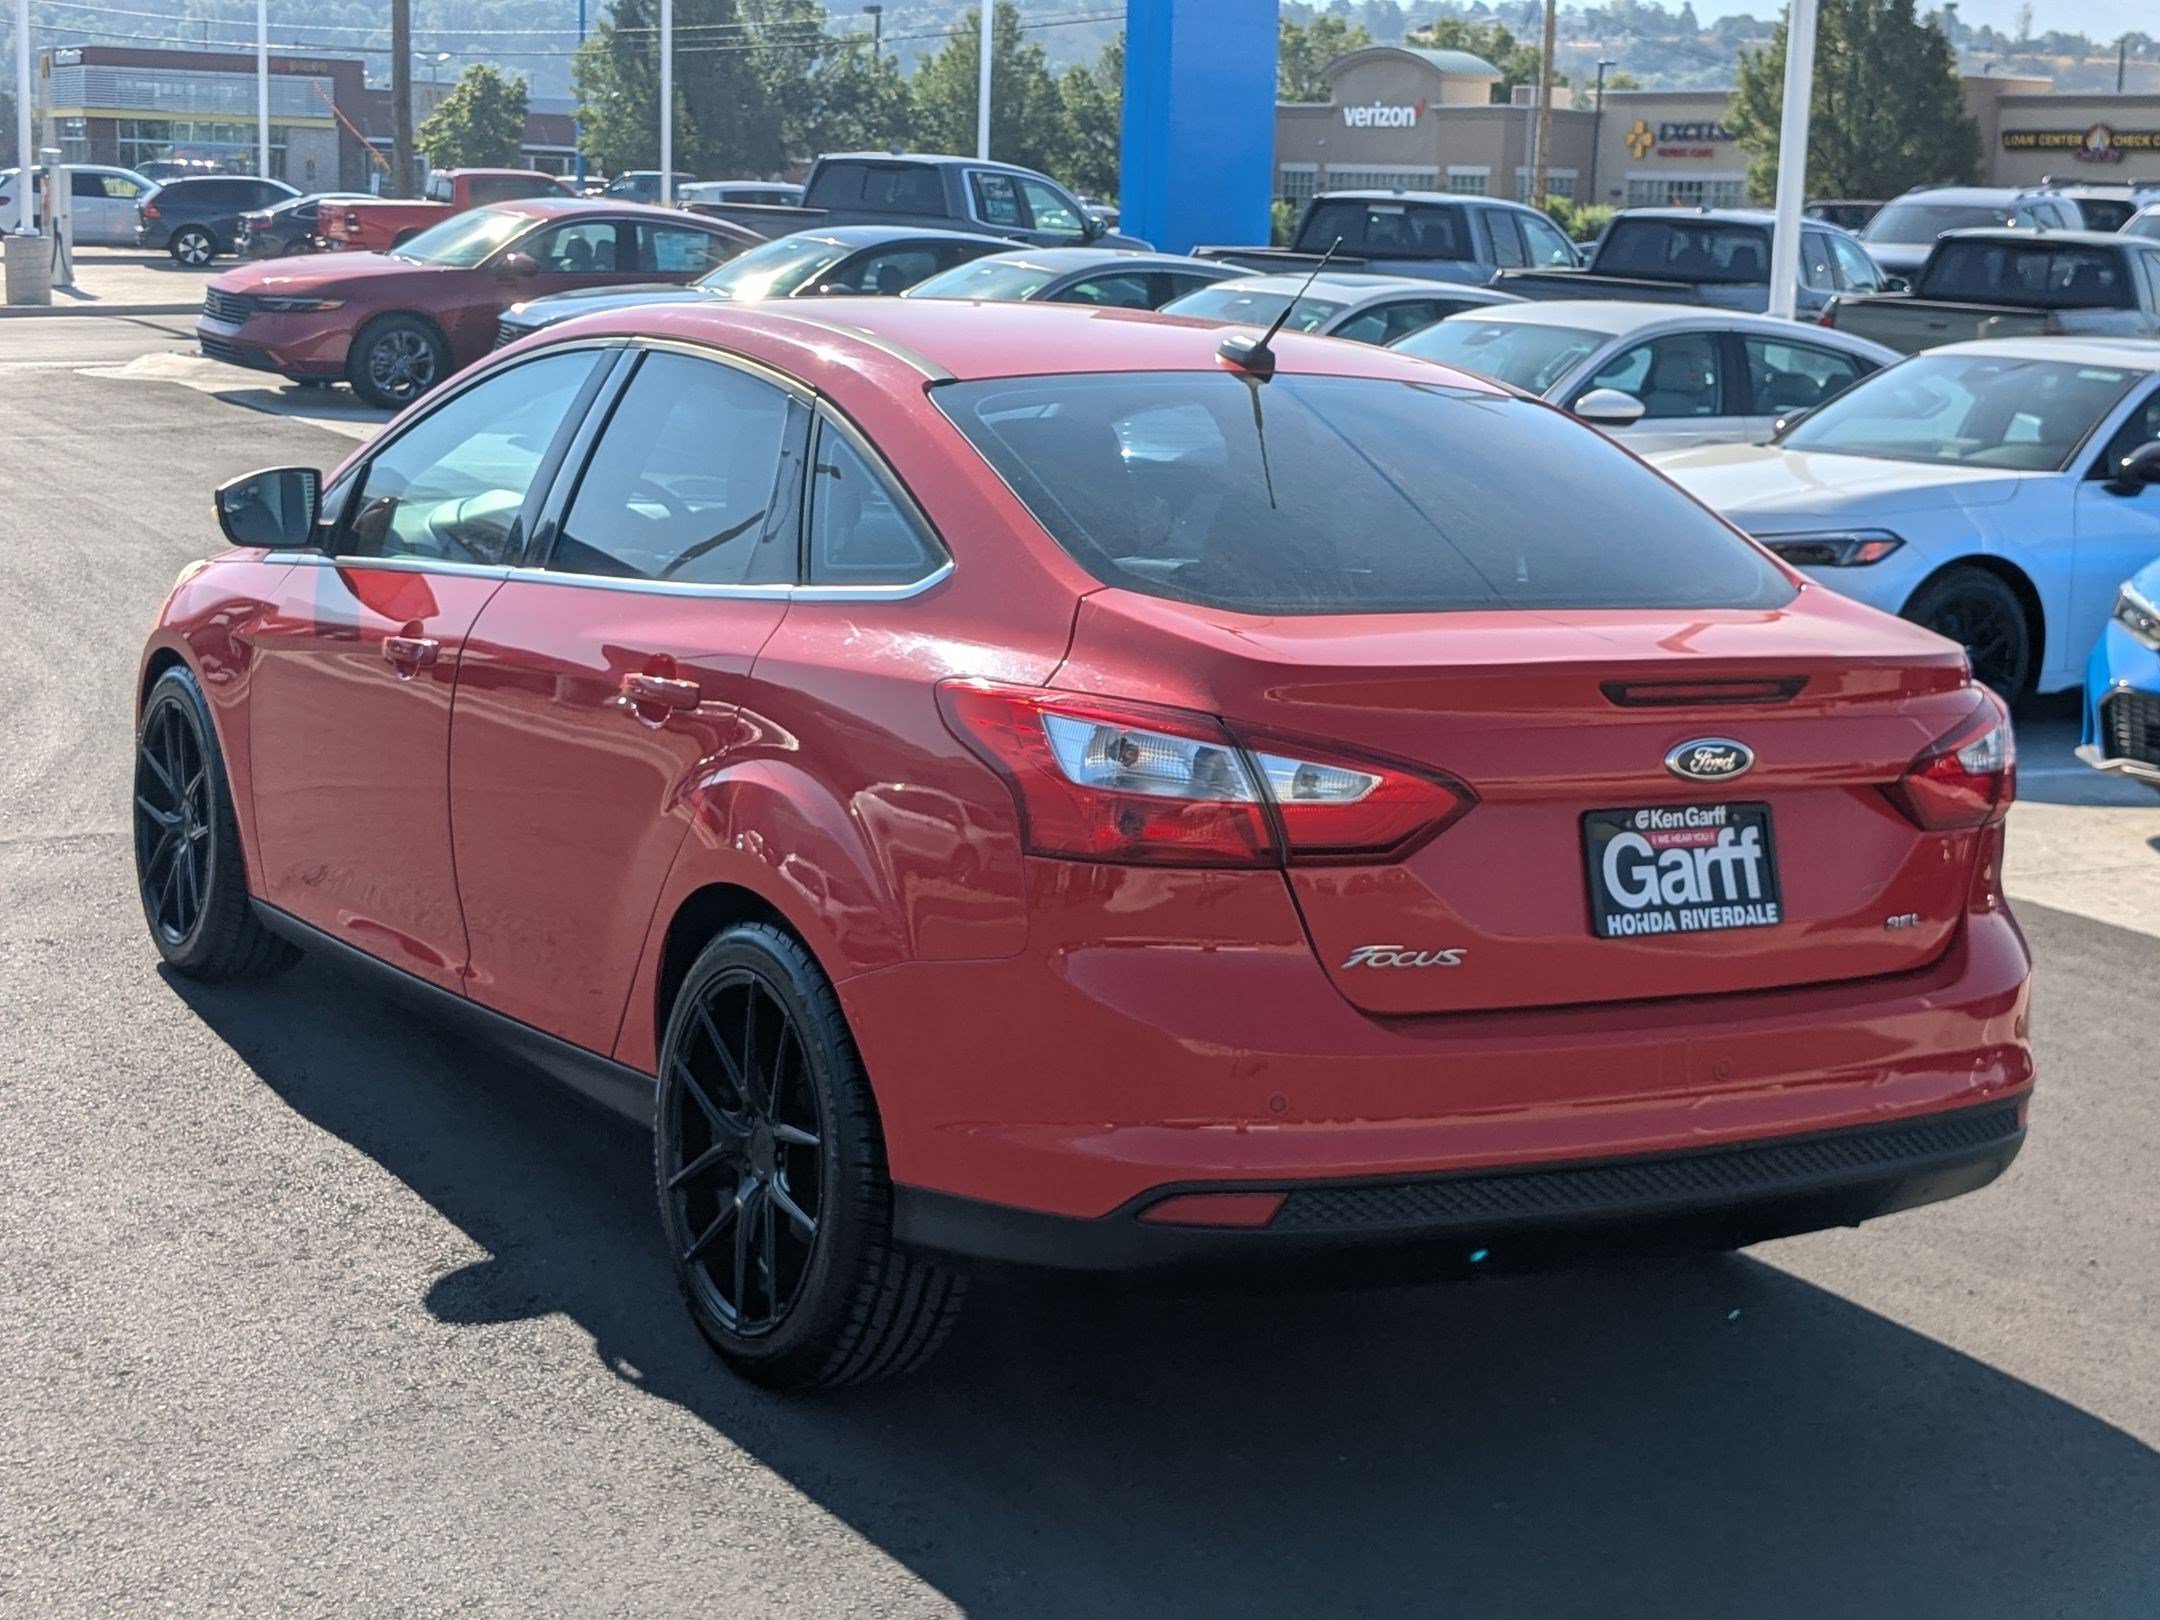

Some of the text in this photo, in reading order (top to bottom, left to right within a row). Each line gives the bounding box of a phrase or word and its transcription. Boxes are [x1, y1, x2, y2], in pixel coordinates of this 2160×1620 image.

[1343, 101, 1416, 128] verizon
[2004, 133, 2082, 147] LOAN CENTER
[2111, 135, 2150, 147] CHECK
[1689, 746, 1737, 773] Ford
[1650, 805, 1727, 829] Ken Garff
[1603, 826, 1761, 909] Garff
[1606, 902, 1779, 936] HONDA RIVERDALE
